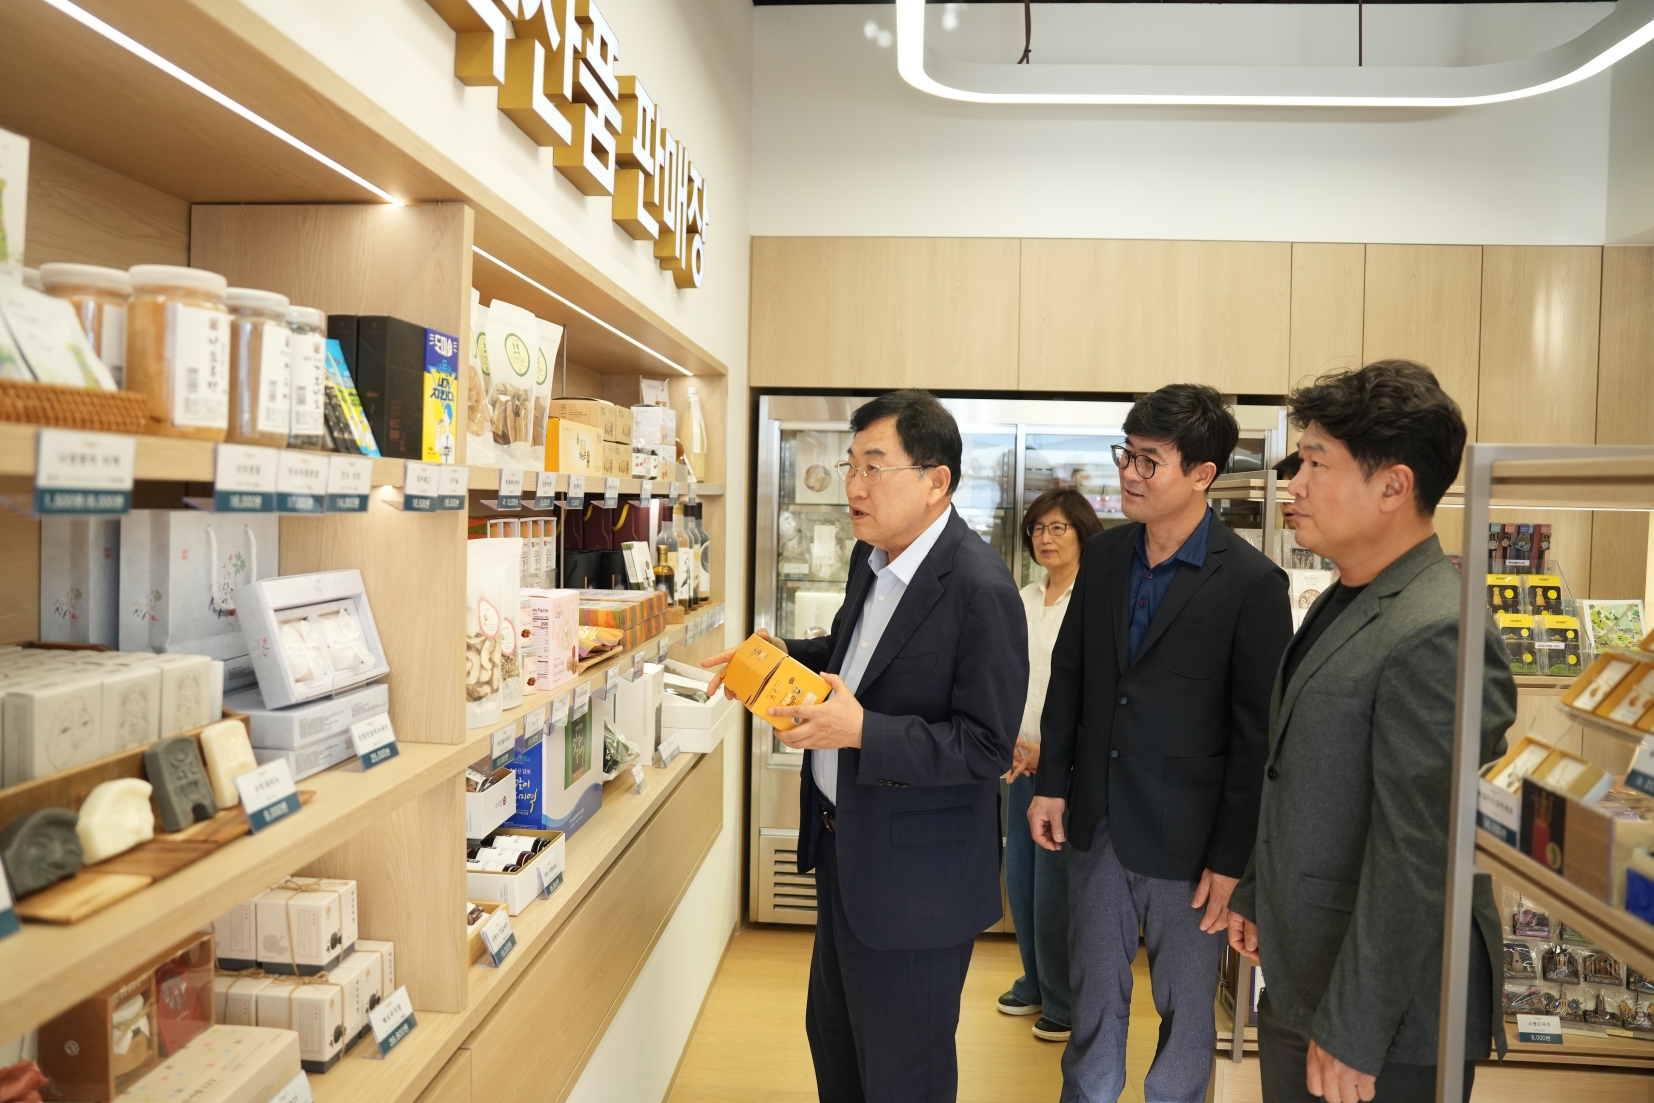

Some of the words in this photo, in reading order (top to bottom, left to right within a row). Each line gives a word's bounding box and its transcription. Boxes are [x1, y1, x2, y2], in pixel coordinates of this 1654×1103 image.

[465, 0, 623, 196] 산품
[633, 75, 710, 289] 판매장
[435, 334, 453, 358] 도미솔
[430, 388, 454, 402] 지킨다
